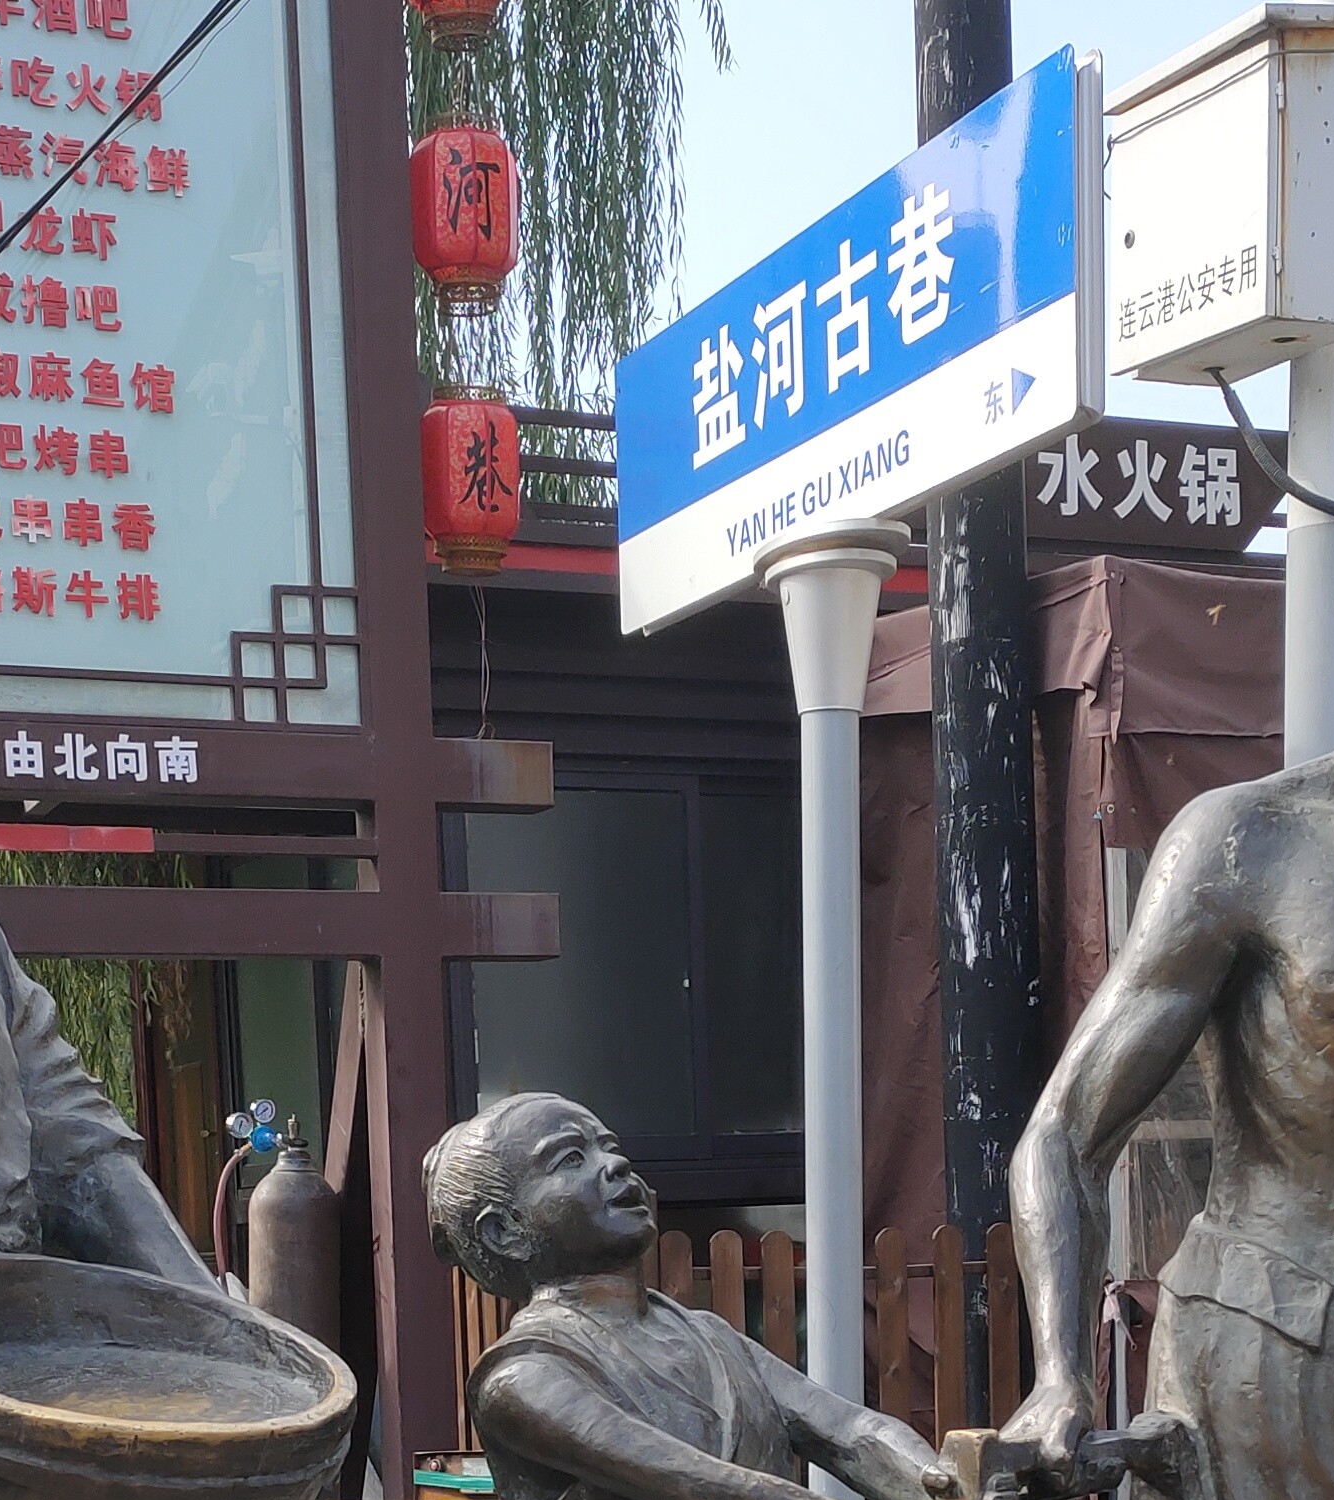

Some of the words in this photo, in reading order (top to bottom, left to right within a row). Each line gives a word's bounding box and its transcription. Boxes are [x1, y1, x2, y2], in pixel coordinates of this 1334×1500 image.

[442, 147, 501, 241] 河
[692, 182, 955, 471] 盐河古巷
[1119, 244, 1257, 342] 连云港公安专用
[984, 380, 1004, 425] 东
[458, 421, 514, 512] 巷
[726, 508, 767, 557] YAN
[772, 491, 796, 534] HE
[802, 471, 832, 516] GU
[838, 429, 910, 499] XIANG
[1036, 433, 1242, 526] 水火锅
